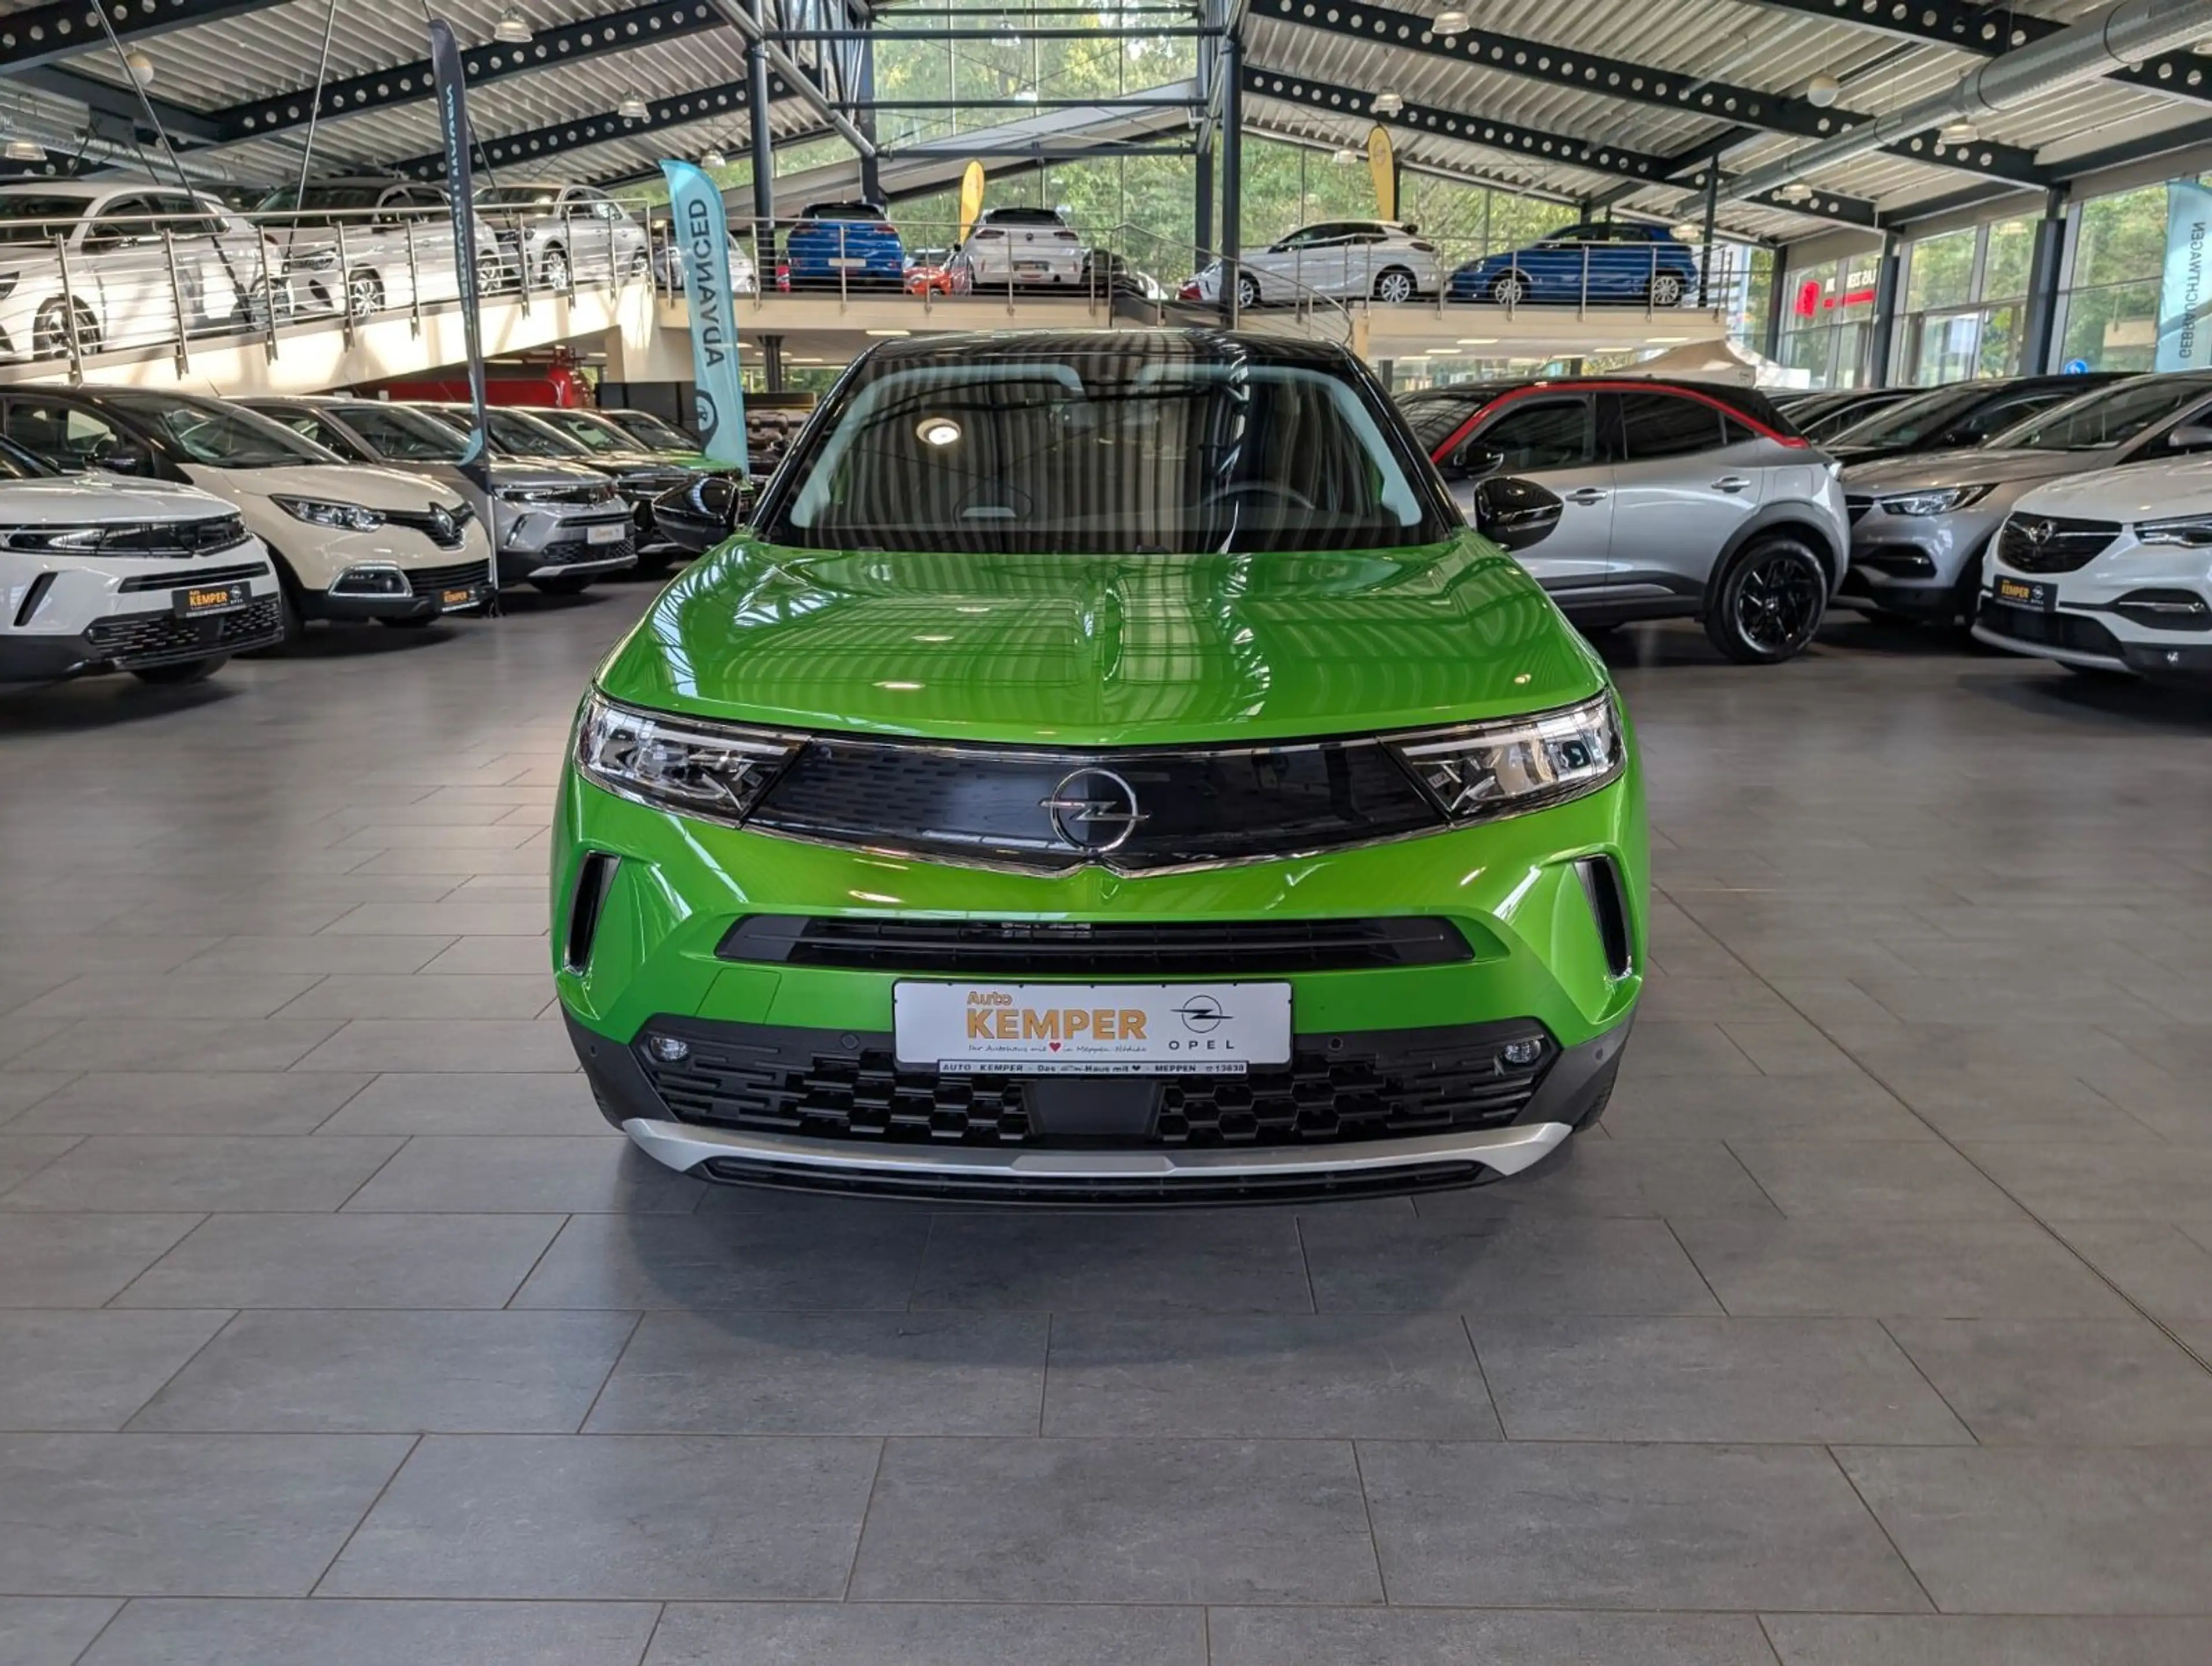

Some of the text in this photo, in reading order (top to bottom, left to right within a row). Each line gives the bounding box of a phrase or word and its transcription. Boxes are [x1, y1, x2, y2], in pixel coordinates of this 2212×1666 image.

[189, 591, 227, 606] KEMPER
[967, 991, 1013, 1005] Auto
[967, 1008, 1147, 1040] KEMPER
[1169, 1041, 1234, 1050] OPEL
